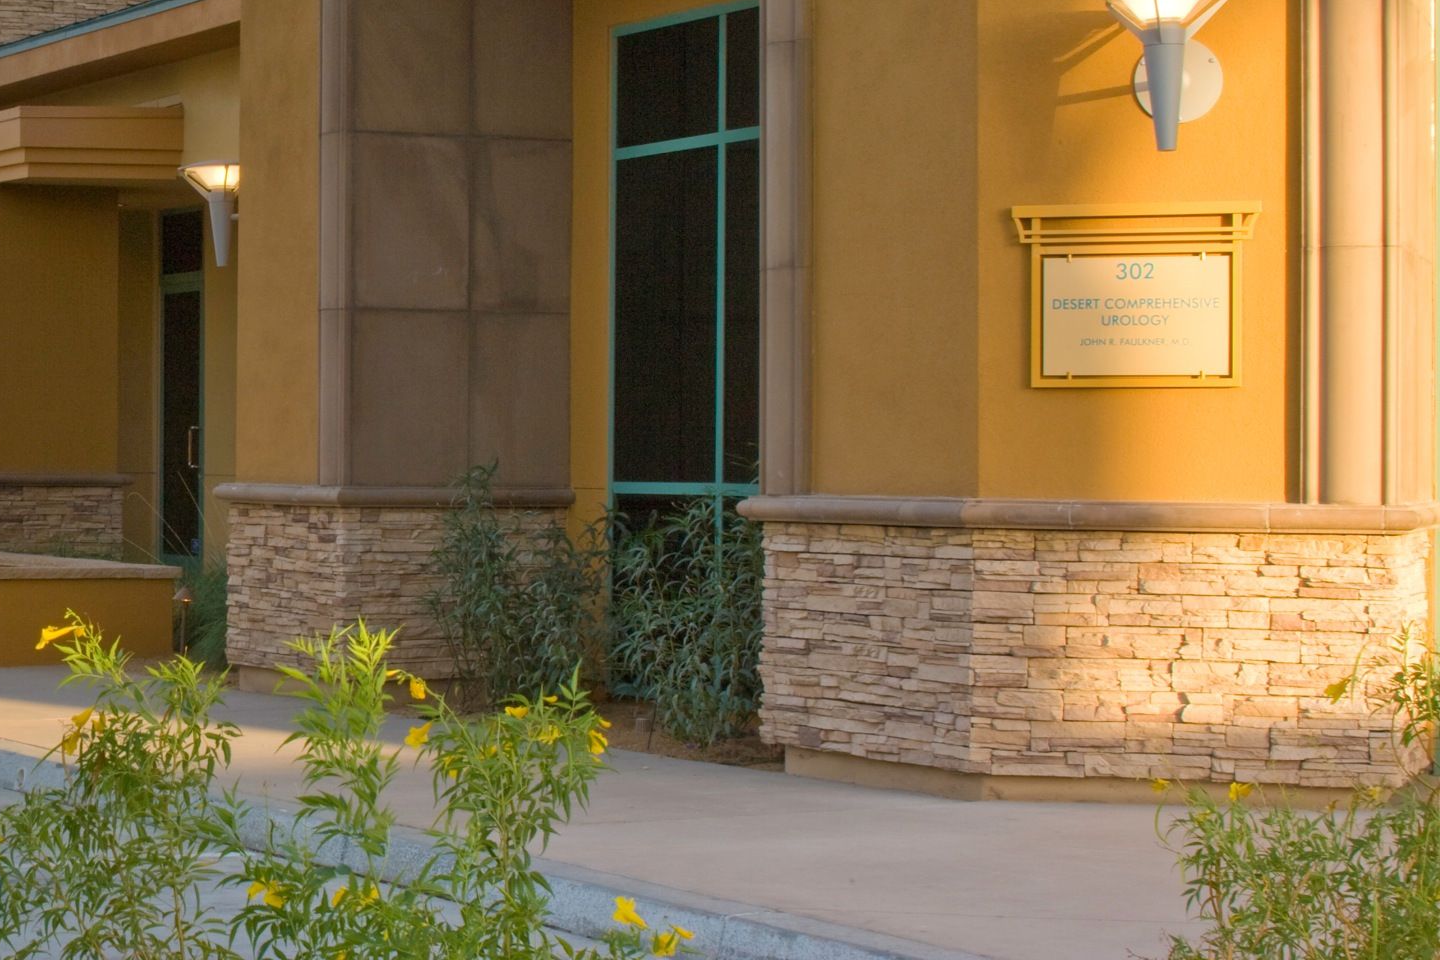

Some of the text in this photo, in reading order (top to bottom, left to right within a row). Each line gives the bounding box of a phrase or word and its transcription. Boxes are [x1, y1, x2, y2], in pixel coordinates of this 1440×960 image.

[1115, 262, 1155, 281] 302
[1052, 297, 1221, 311] DESERT COMPREHENSIVE
[1101, 314, 1170, 327] UROLOGY
[1079, 337, 1107, 347] JOHN
